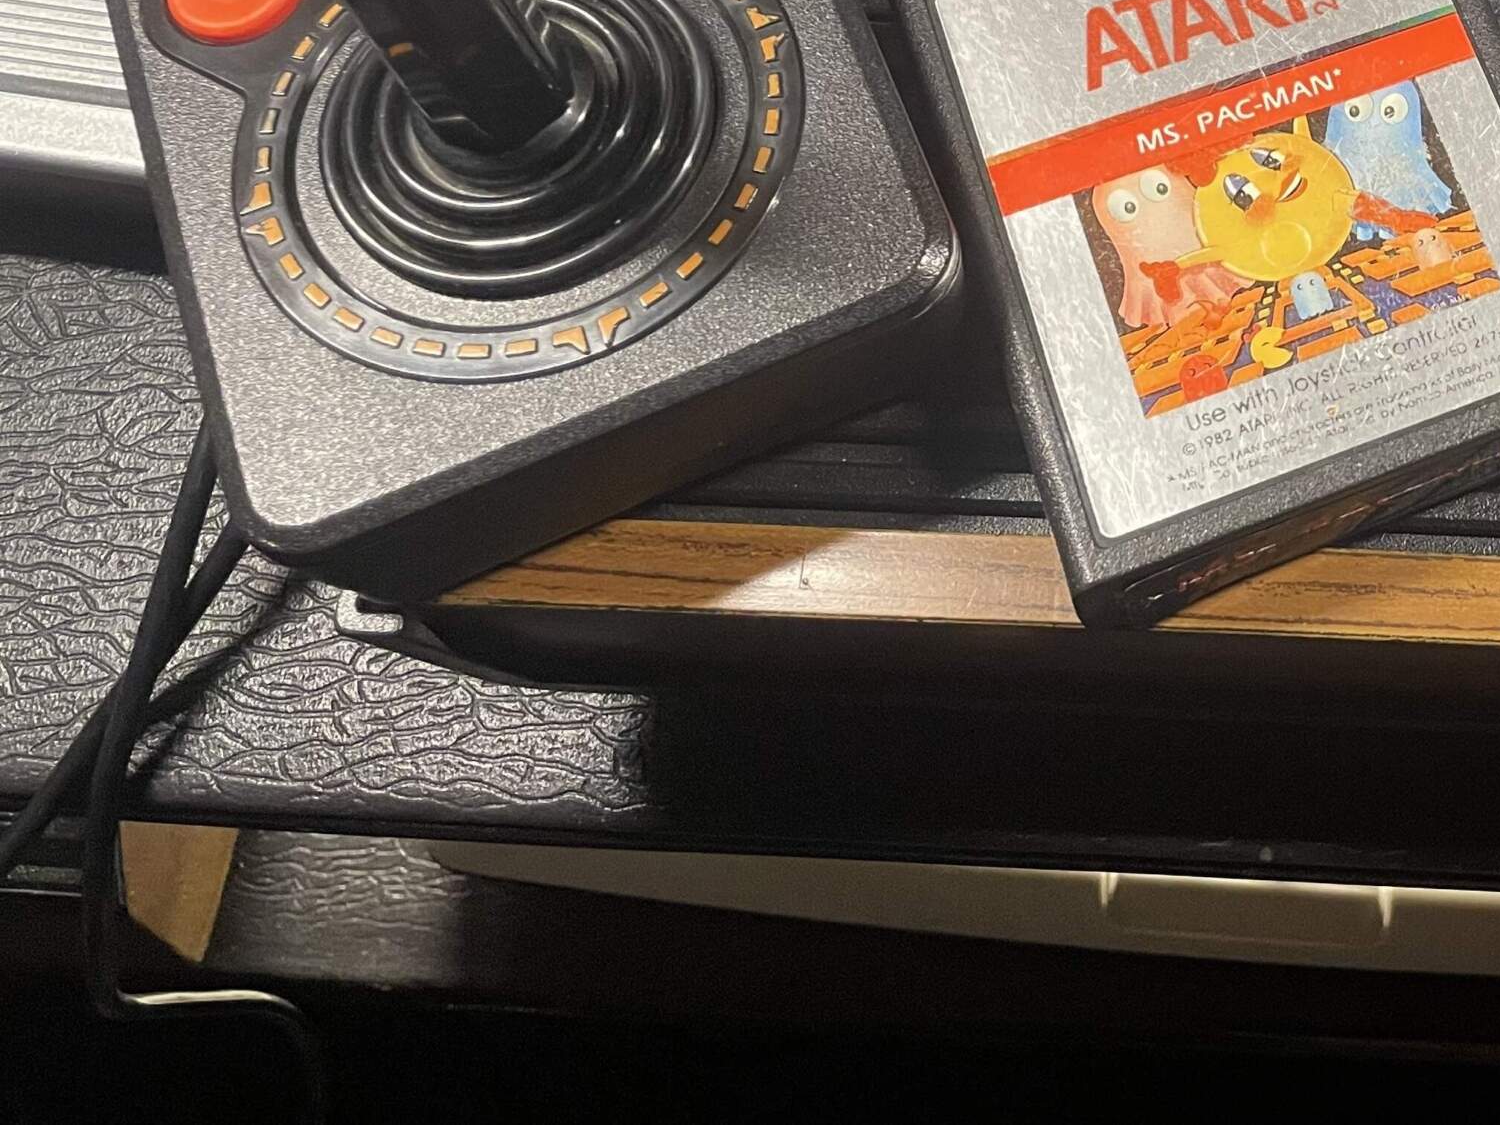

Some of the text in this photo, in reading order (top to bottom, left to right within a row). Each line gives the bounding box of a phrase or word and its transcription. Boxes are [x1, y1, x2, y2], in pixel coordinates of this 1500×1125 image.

[1135, 123, 1190, 155] MS.
[1184, 402, 1228, 433] Use
[1230, 383, 1280, 416] with
[1281, 349, 1371, 400] Joystick
